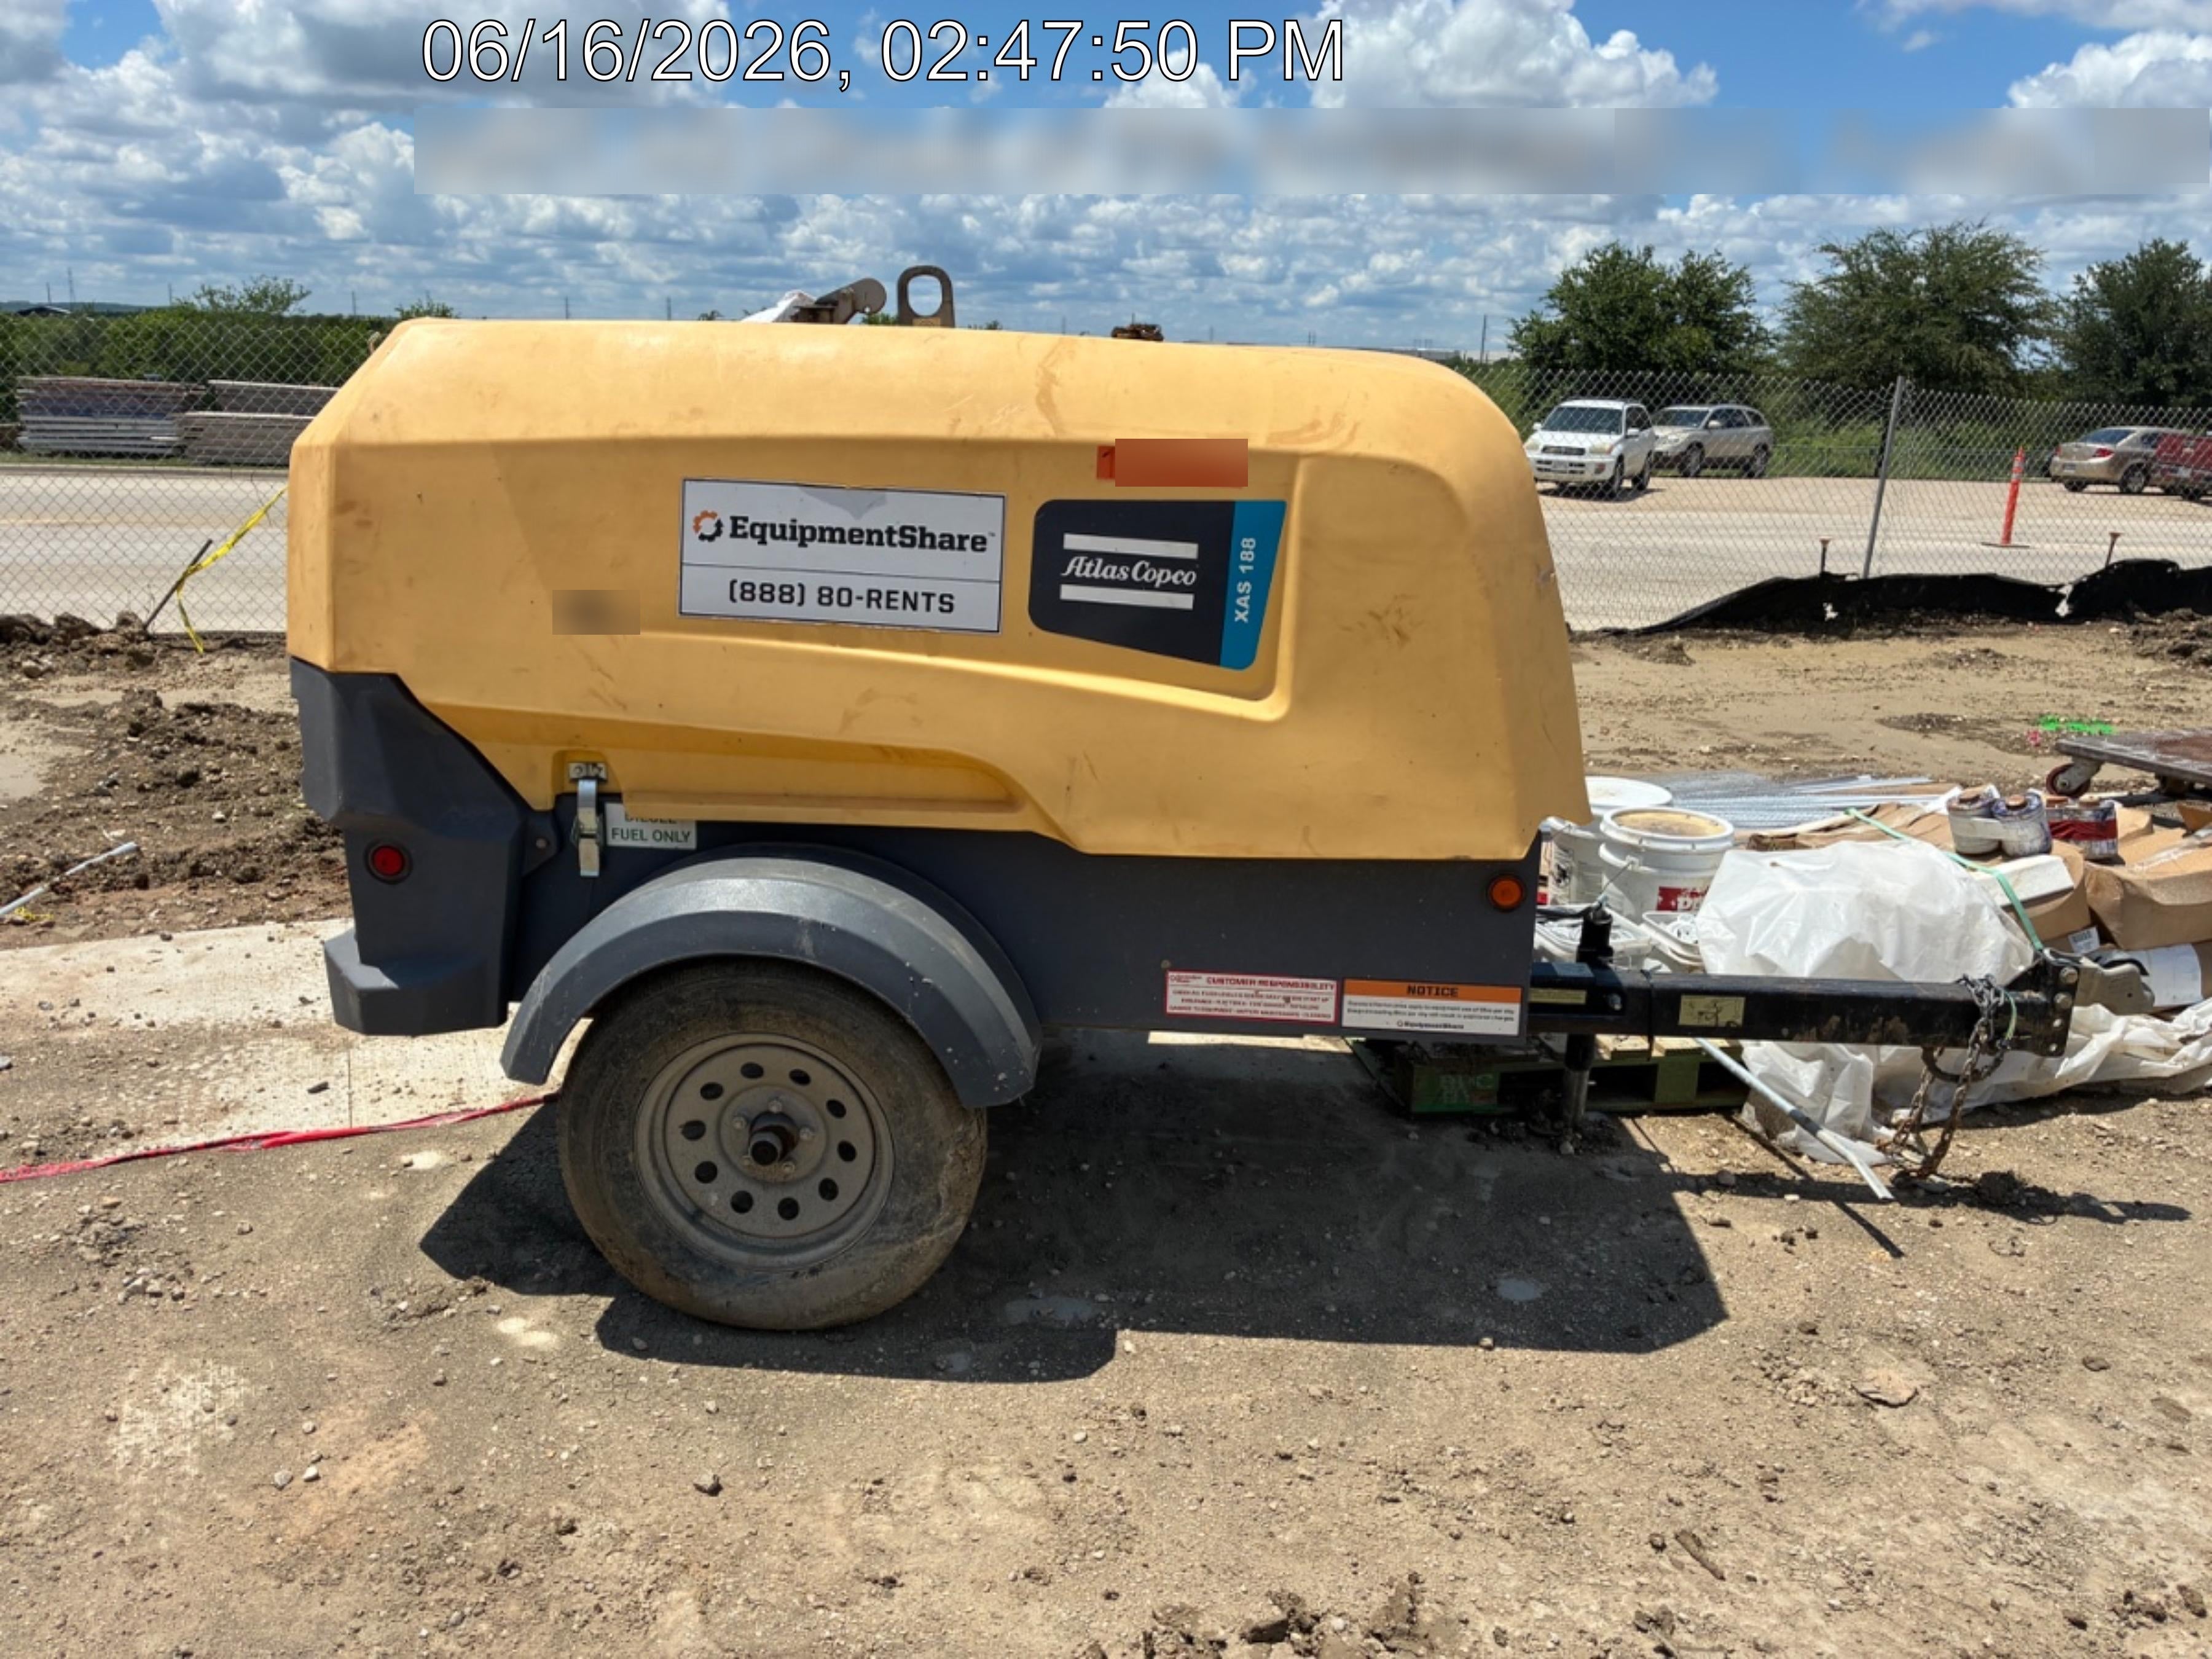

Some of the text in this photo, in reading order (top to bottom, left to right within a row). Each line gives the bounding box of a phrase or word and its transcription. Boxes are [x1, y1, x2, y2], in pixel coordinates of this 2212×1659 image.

[729, 516, 988, 552] EquipmentShare
[1061, 555, 1198, 588] Atlas Copco
[1234, 538, 1255, 622] XAS 188
[729, 579, 955, 614] (888) 80-RENTS
[611, 827, 691, 843] FUEL ONLY
[1406, 984, 1459, 998] NOTICE
